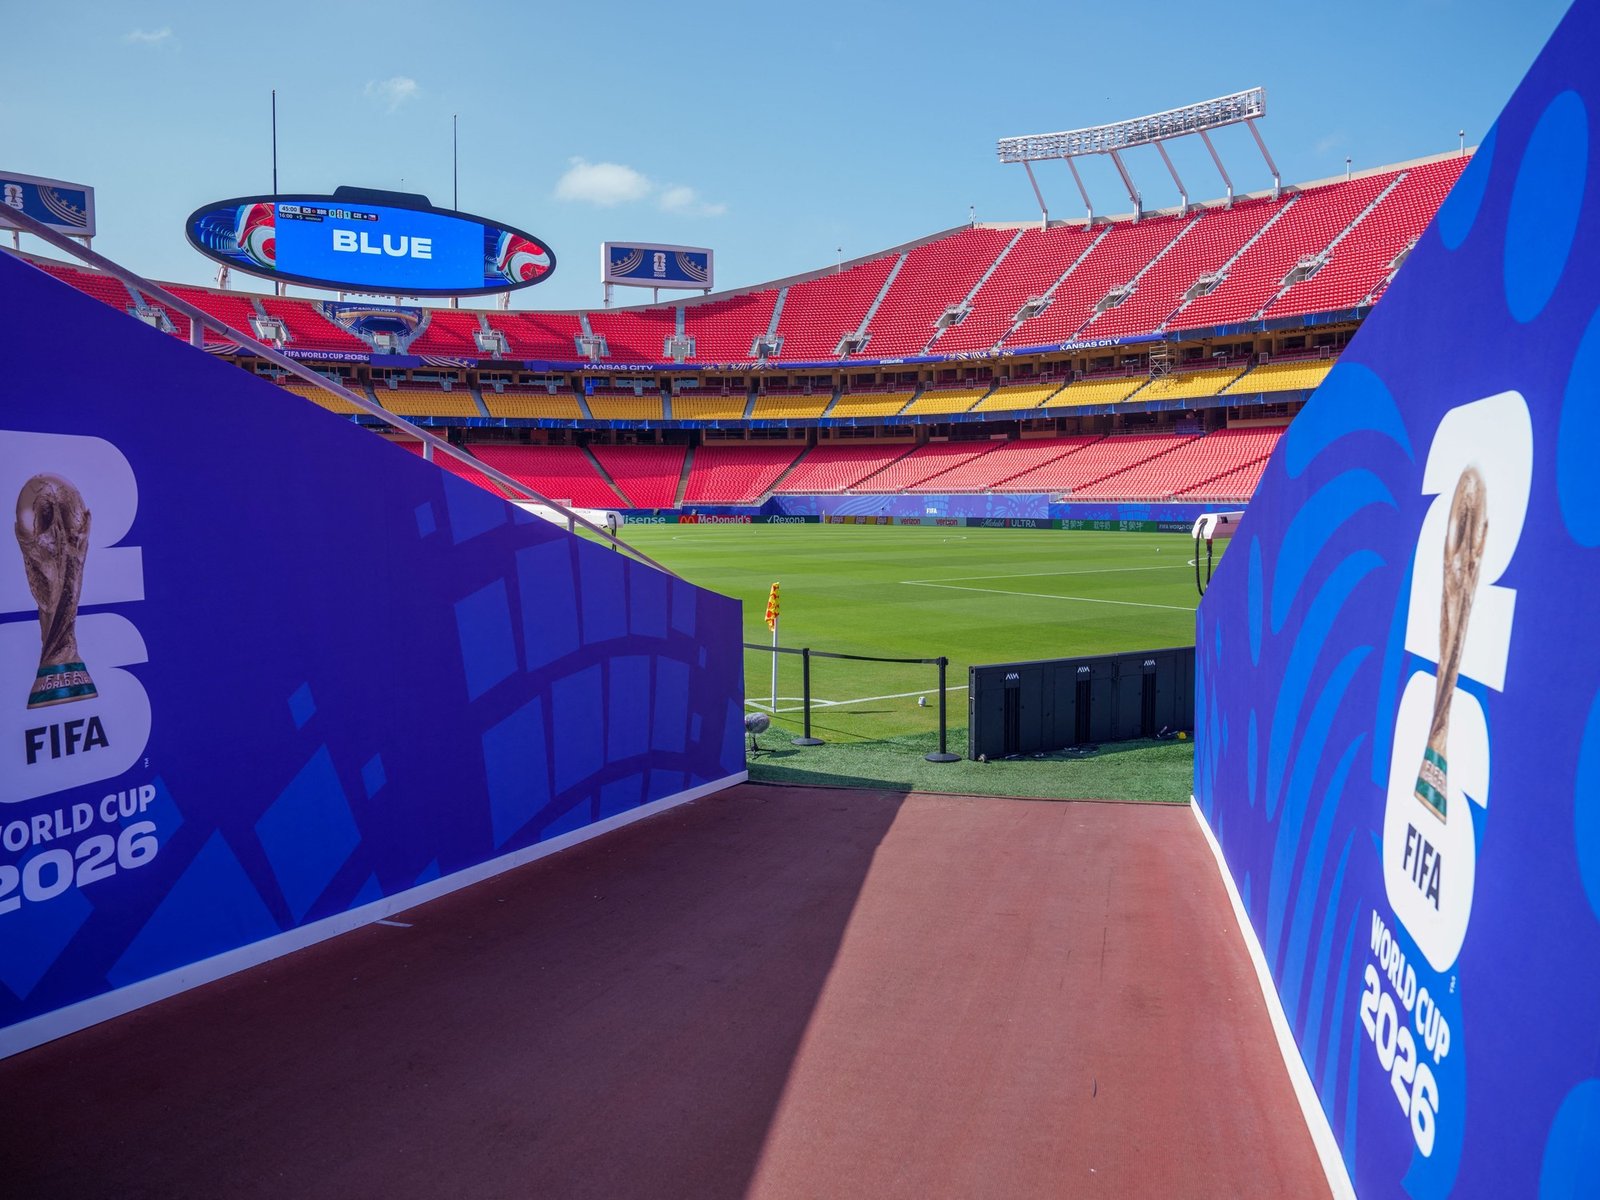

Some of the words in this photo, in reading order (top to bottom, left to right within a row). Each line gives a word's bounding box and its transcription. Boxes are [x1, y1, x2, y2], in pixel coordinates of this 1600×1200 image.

[333, 229, 433, 260] BLUE
[283, 350, 300, 358] FIFA
[300, 351, 328, 359] WORLD
[1060, 341, 1097, 351] KANSAS
[697, 514, 752, 524] McDonald's
[773, 514, 806, 524] Rexona
[1011, 519, 1037, 528] ULTRA
[46, 671, 82, 683] FIFA
[25, 716, 109, 765] FIFA
[99, 783, 157, 818] CUP
[1402, 822, 1443, 912] FIFA
[1371, 908, 1417, 1013] WORLD
[1415, 986, 1451, 1066] CUP
[1359, 963, 1440, 1158] 2026
